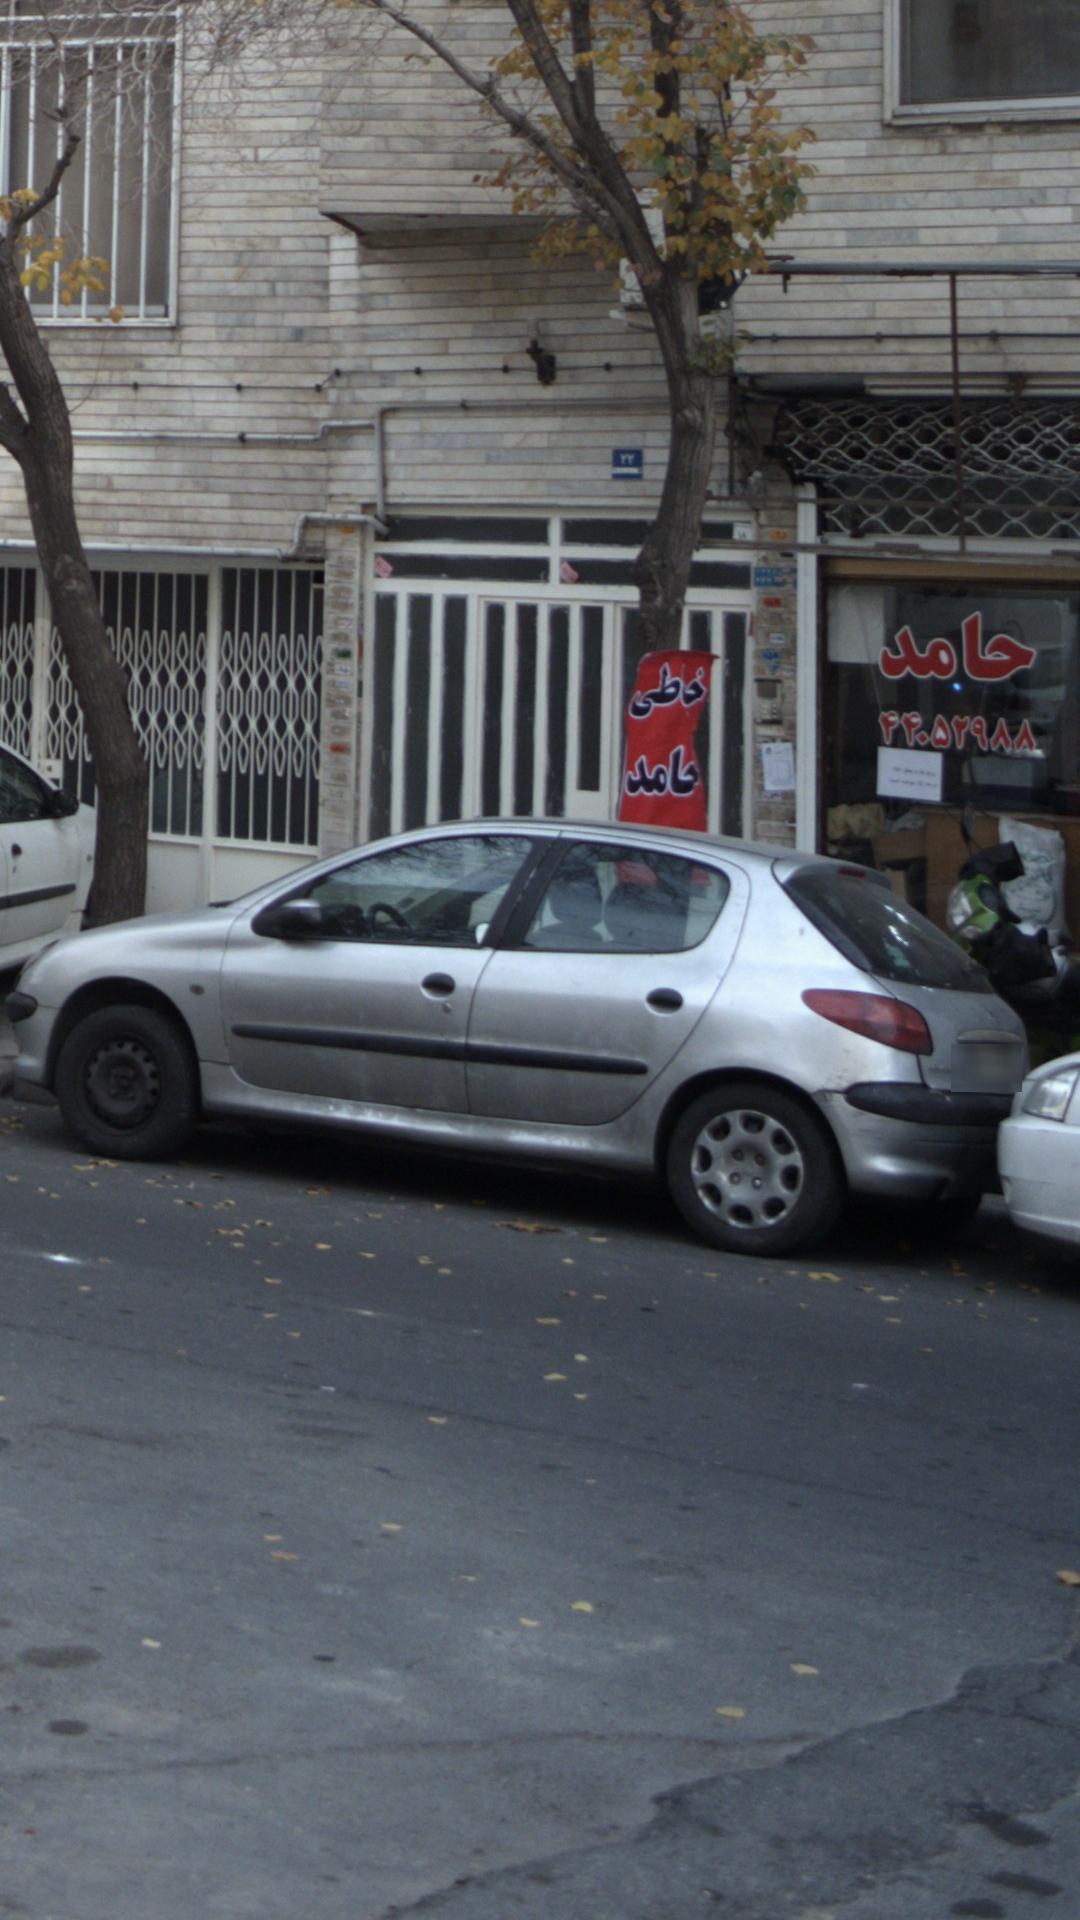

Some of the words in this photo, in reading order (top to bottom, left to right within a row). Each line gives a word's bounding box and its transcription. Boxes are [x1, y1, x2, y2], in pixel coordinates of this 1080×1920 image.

[879, 611, 1036, 681] حامد
[629, 662, 706, 719] خطی
[879, 711, 1036, 751] ۴۴۰۵۲۹۸۸
[625, 744, 700, 796] حامد
